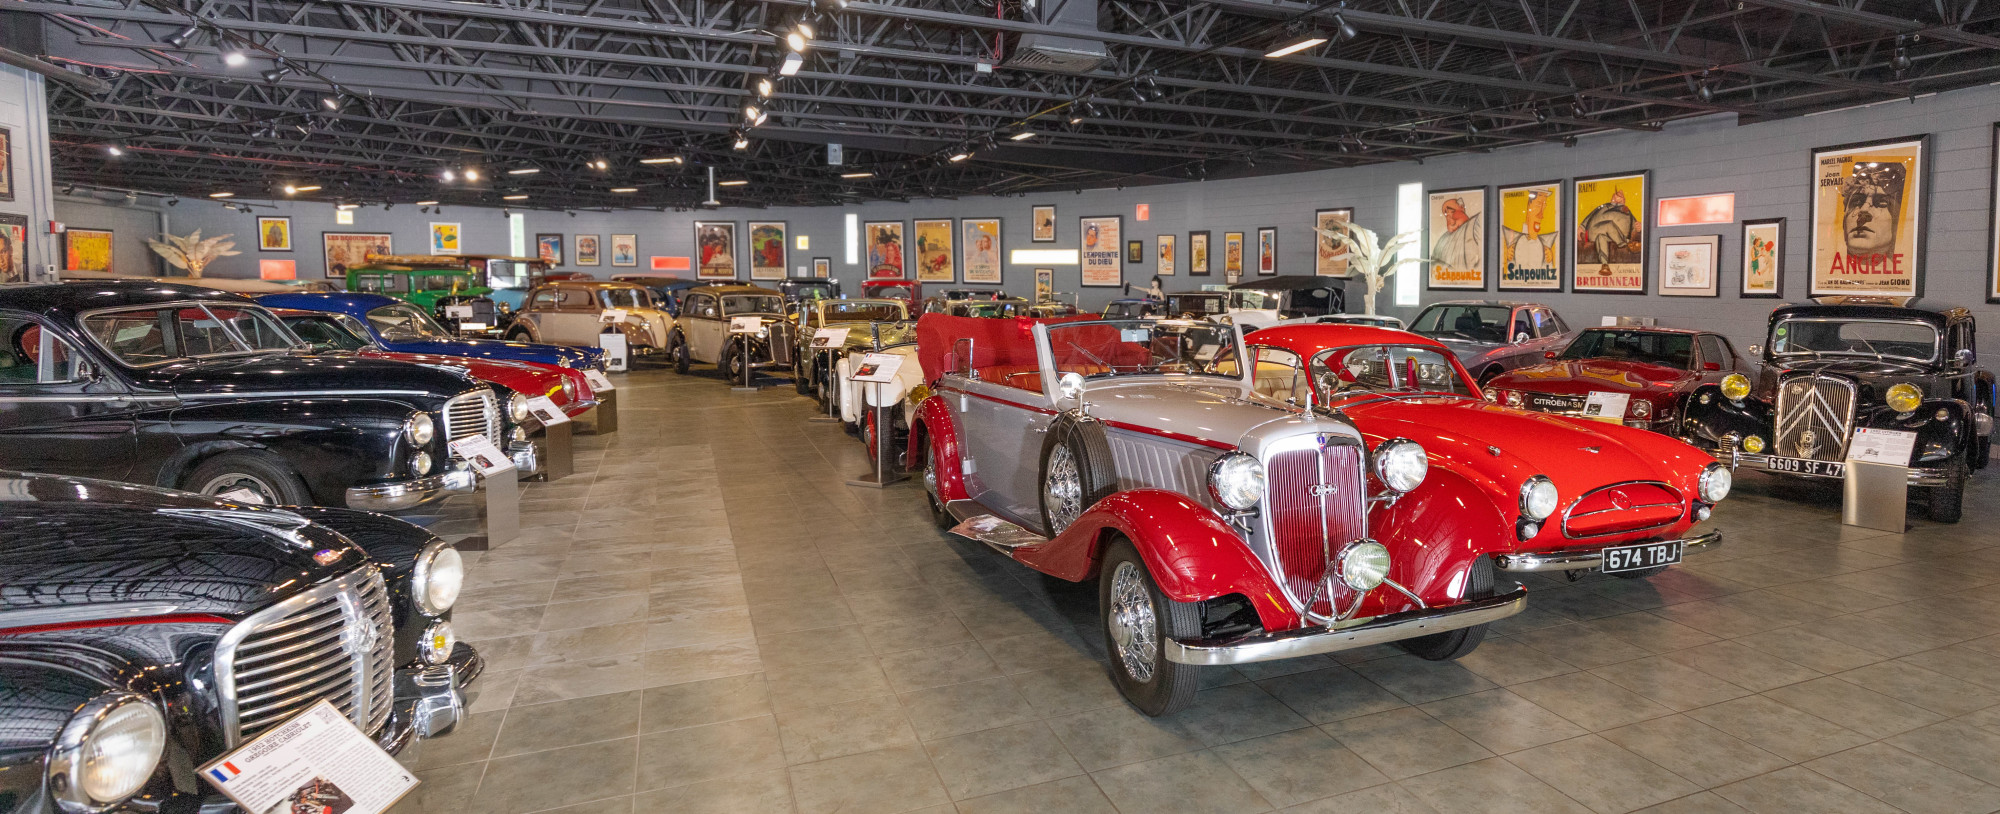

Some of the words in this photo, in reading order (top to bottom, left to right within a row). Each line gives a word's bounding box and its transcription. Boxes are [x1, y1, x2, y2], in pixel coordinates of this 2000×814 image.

[1820, 177, 1844, 187] SERVAIS
[1435, 265, 1481, 281] Schpountz
[1508, 263, 1557, 282] Schpountz
[1576, 276, 1642, 287] BROTONNEAU
[1890, 278, 1910, 286] GIONO
[1770, 458, 1799, 472] 6609
[1804, 463, 1820, 474] SF
[1826, 465, 1840, 476] 47
[1609, 548, 1642, 569] 674
[1647, 543, 1677, 565] TBJ
